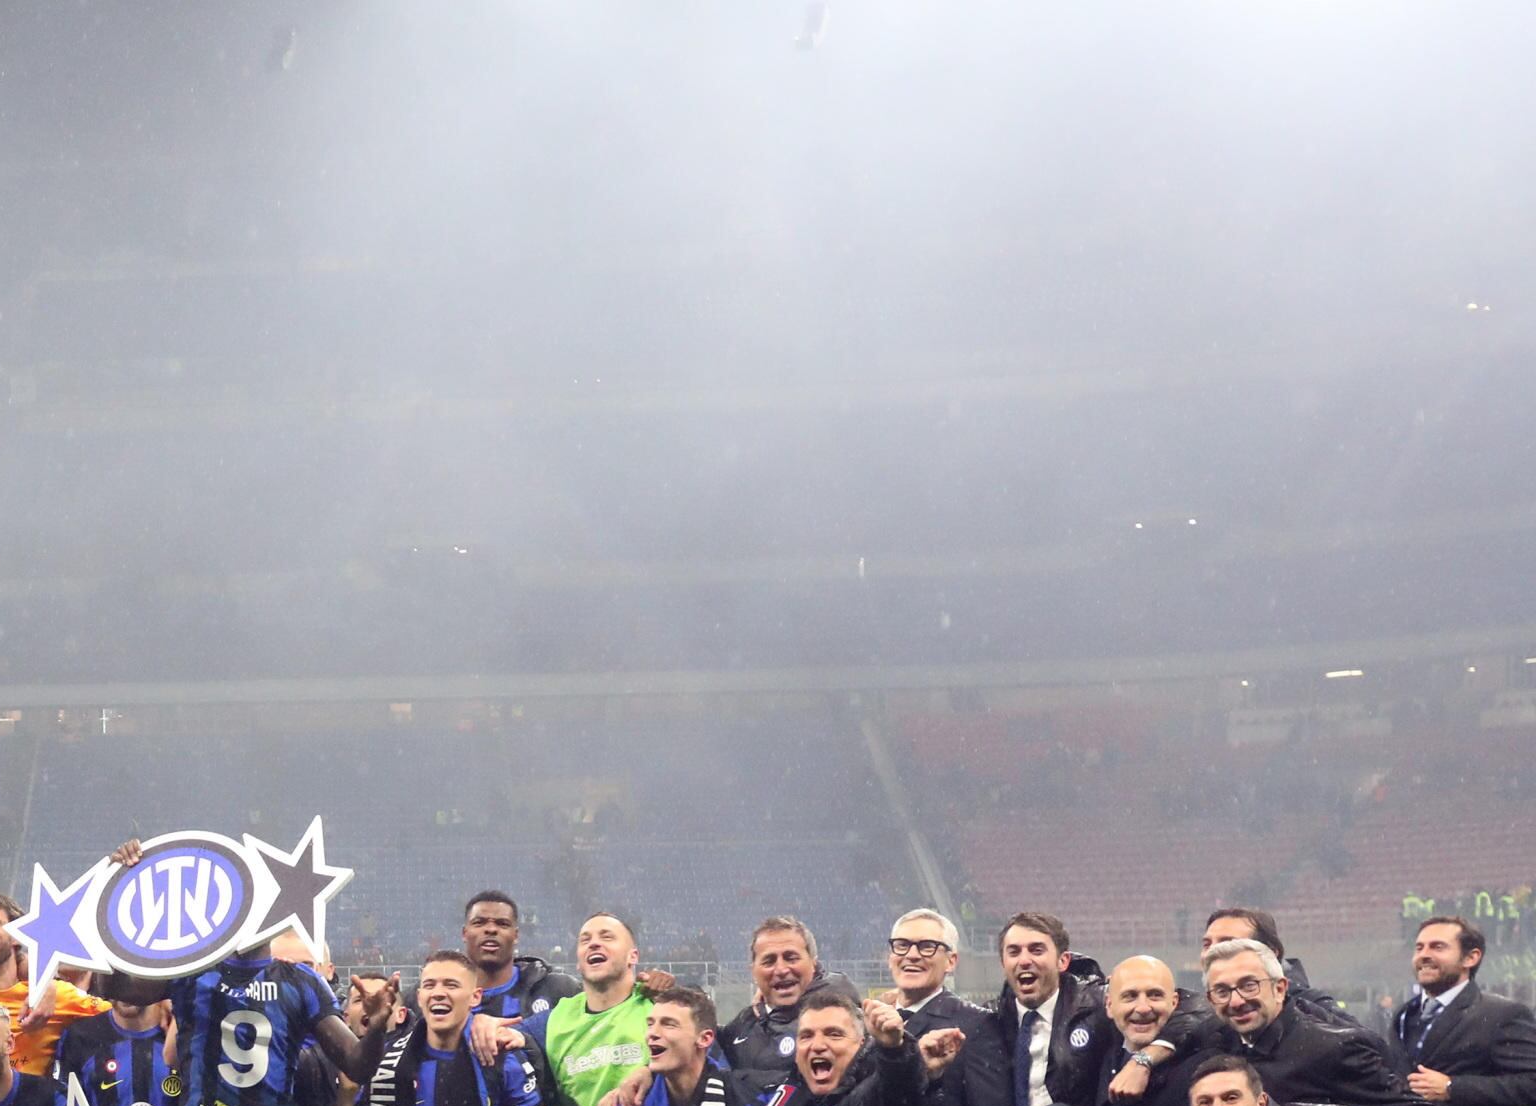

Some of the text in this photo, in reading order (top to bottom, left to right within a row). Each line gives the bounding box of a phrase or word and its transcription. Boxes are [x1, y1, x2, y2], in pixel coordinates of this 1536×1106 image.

[220, 981, 278, 1002] TRAM
[217, 1009, 273, 1089] 9
[563, 1042, 642, 1077] LeoVgas
